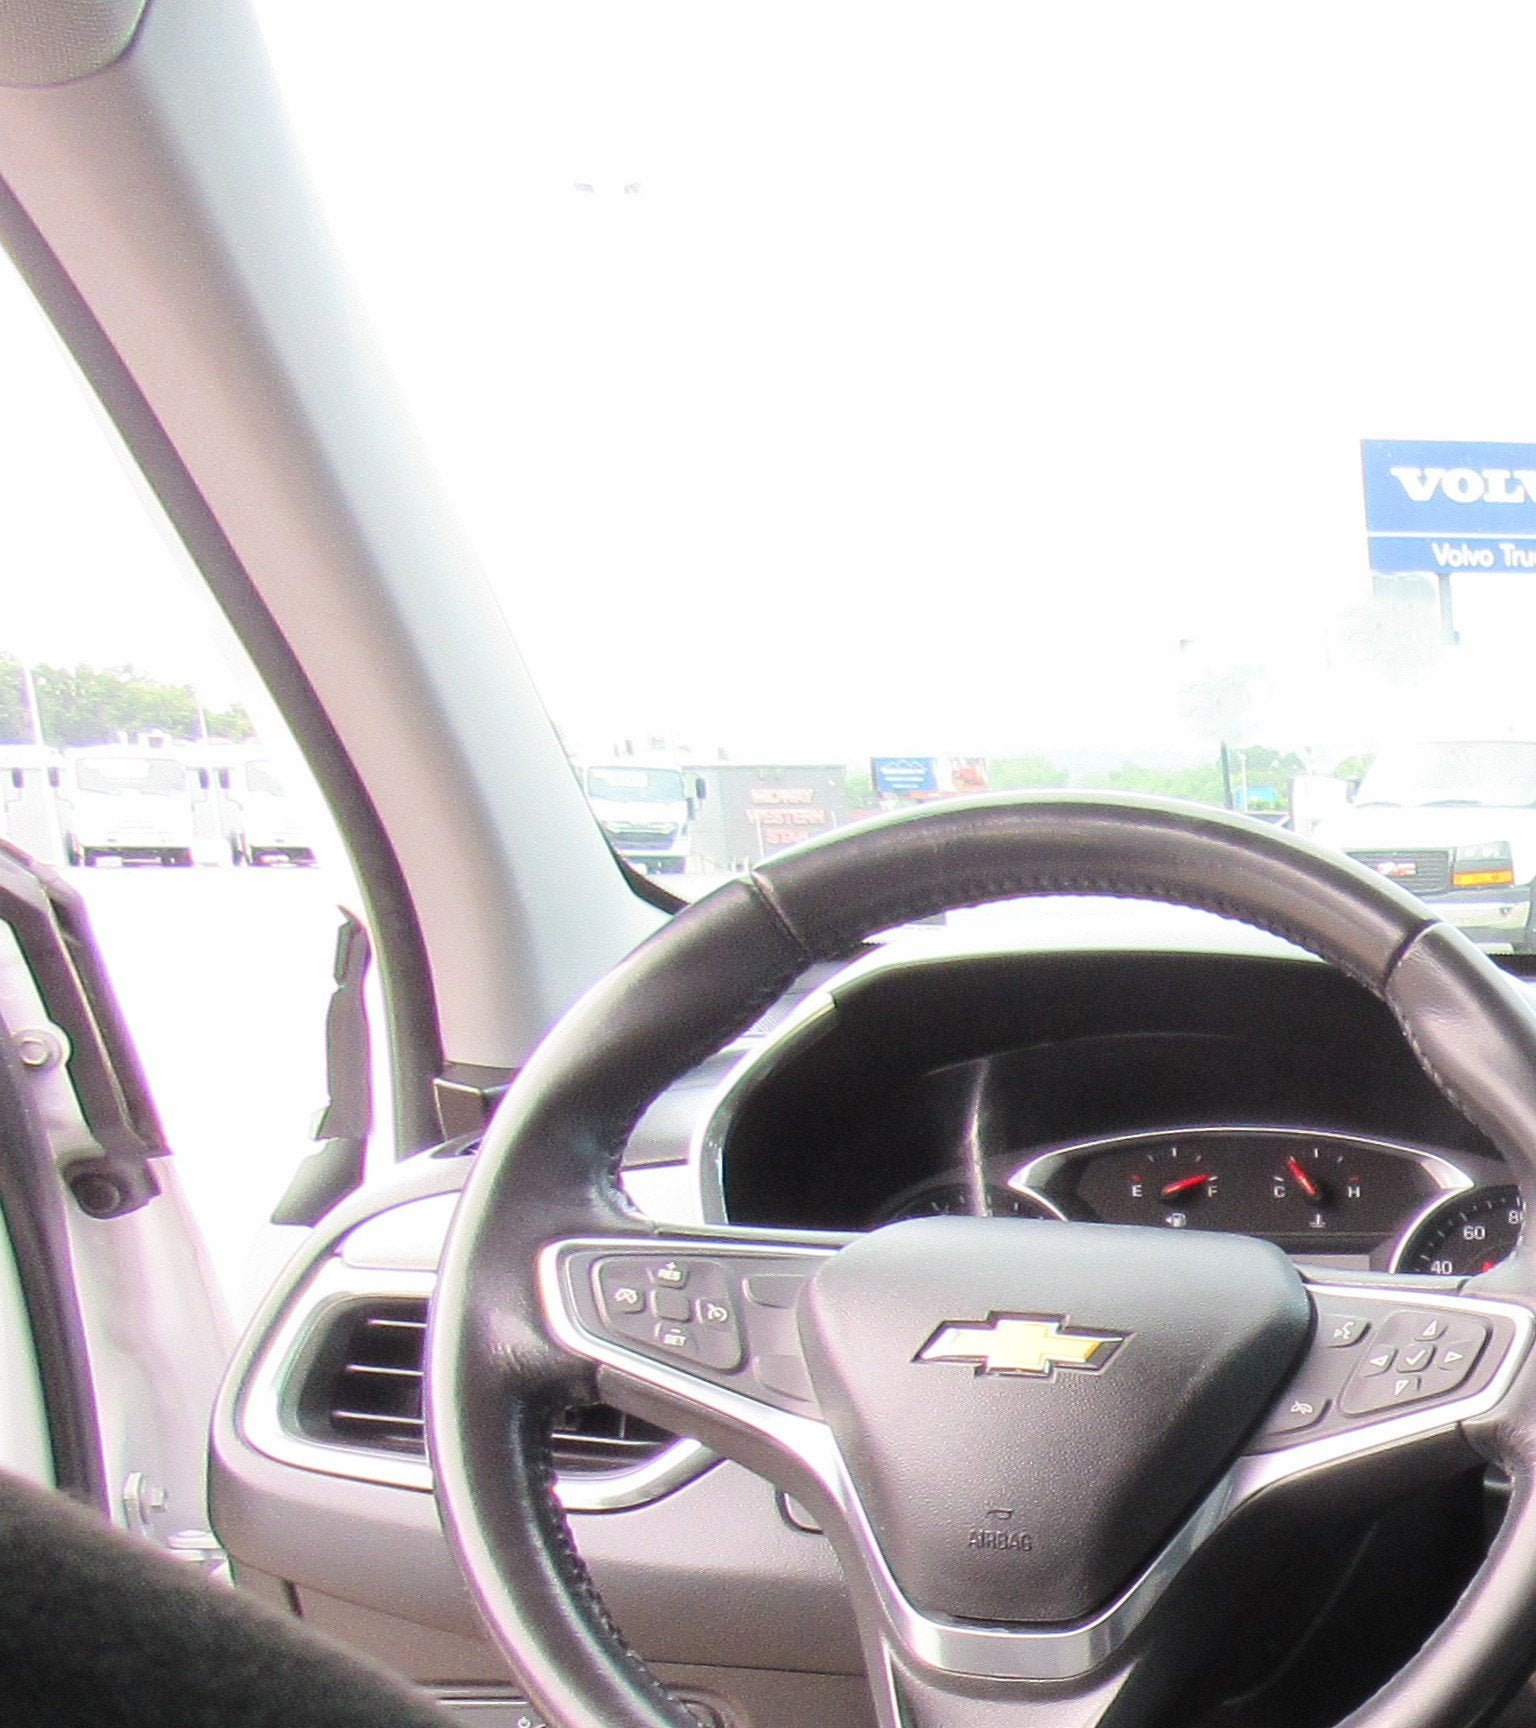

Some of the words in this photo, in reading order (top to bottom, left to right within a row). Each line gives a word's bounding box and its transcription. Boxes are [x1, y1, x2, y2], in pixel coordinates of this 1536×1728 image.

[1431, 542, 1495, 567] Volvo
[1131, 1184, 1143, 1198] E
[1207, 1184, 1218, 1198] F
[1273, 1185, 1287, 1198] C
[1347, 1186, 1361, 1199] H
[1507, 1209, 1523, 1225] 8
[1462, 1225, 1486, 1240] 60
[1430, 1260, 1453, 1275] 40
